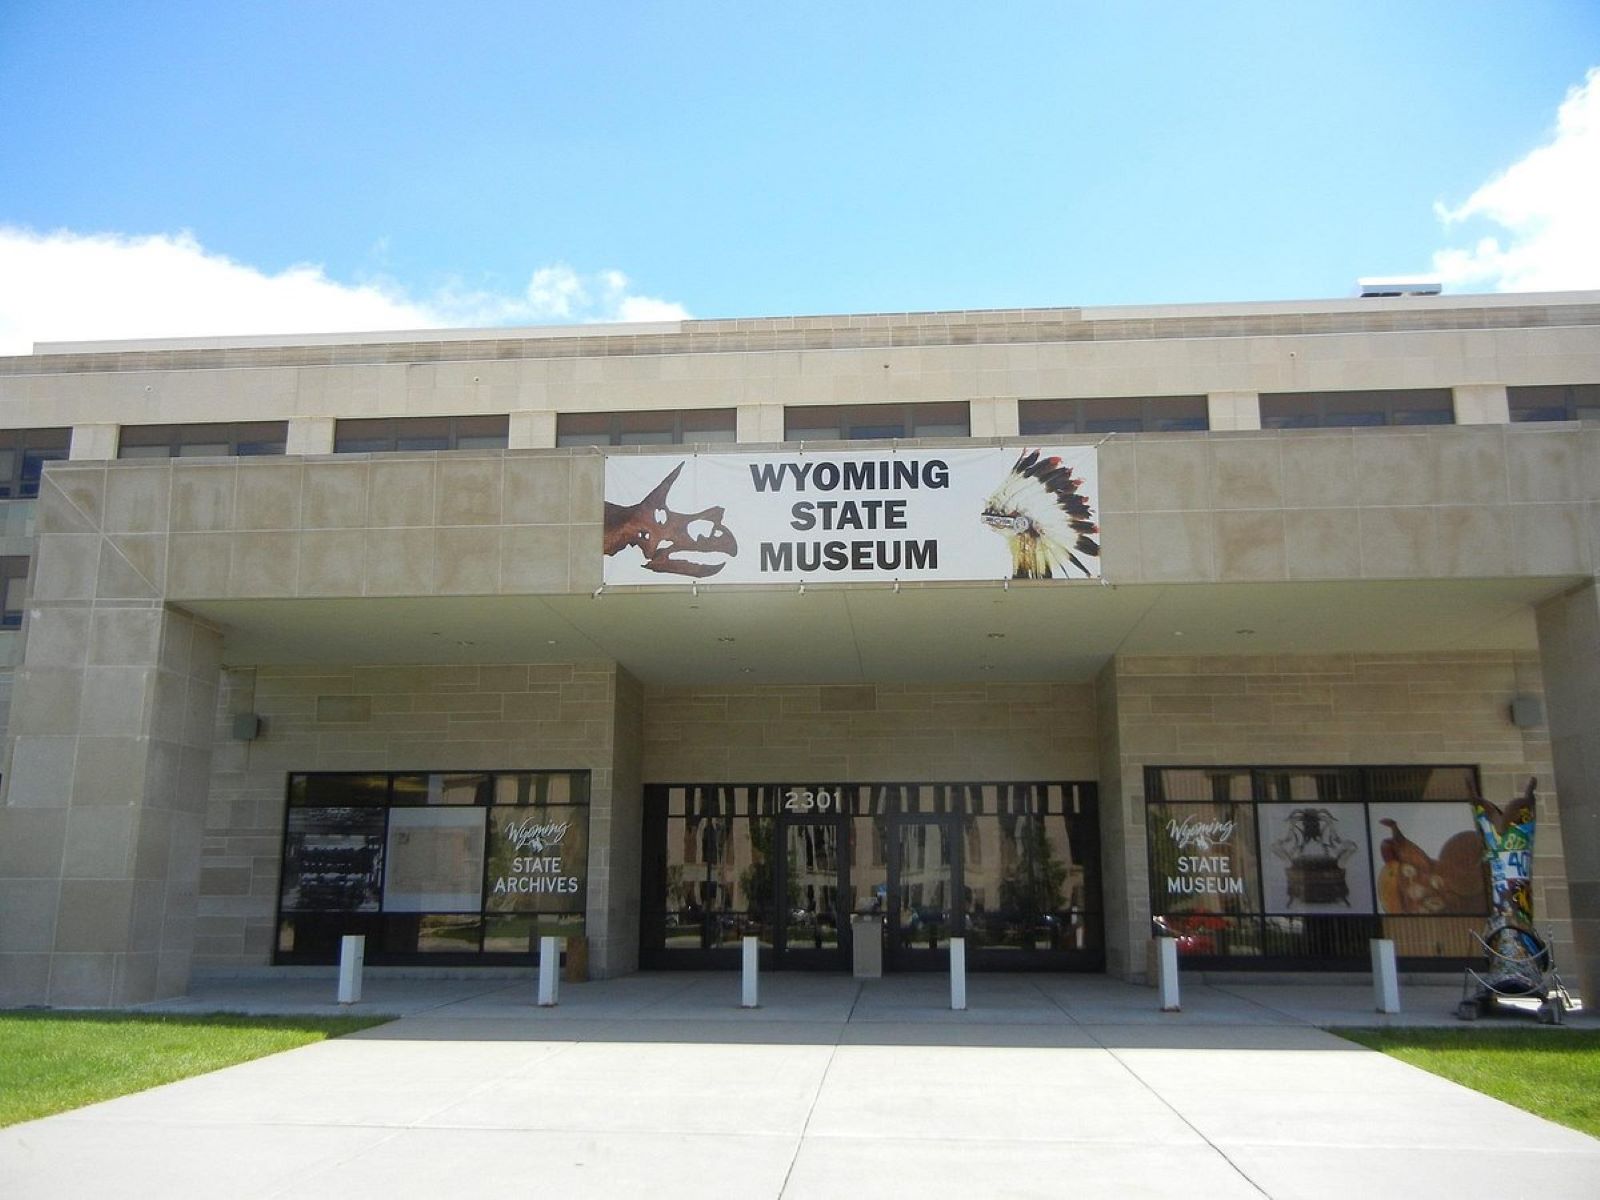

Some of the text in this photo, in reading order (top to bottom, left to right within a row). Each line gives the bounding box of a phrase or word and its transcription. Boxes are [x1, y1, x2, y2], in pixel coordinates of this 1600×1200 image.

[749, 460, 949, 492] WYOMING
[790, 500, 907, 531] STATE
[760, 540, 938, 572] MUSEUM
[784, 791, 841, 809] 2301
[505, 816, 572, 851] Wyoming
[1166, 815, 1237, 849] Wyoming
[513, 857, 562, 873] STATE
[1178, 856, 1230, 873] STATE
[495, 877, 578, 894] ARCHIVES
[1168, 877, 1243, 894] MUSEUM
